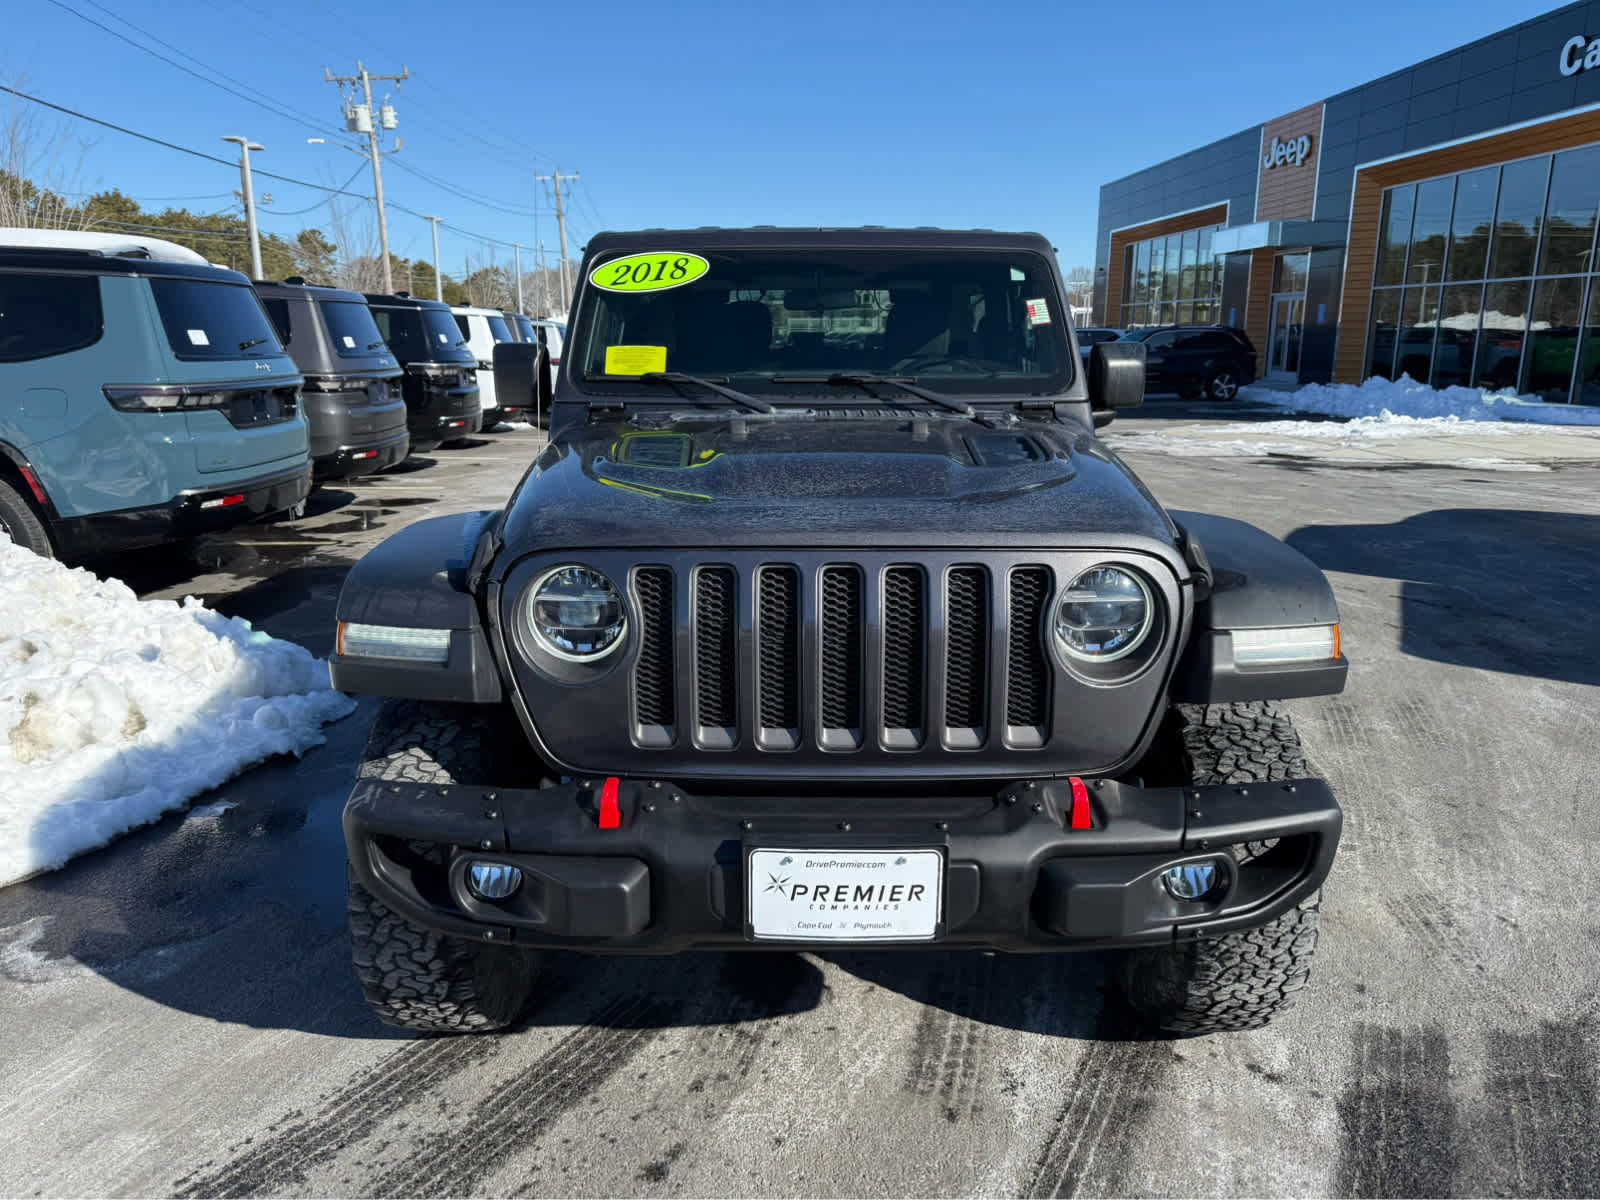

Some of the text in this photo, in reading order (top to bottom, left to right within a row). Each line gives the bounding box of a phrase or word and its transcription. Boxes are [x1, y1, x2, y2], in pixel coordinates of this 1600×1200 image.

[1264, 135, 1311, 169] Jeep
[610, 258, 689, 286] 2018
[790, 884, 925, 902] PREMIER
[809, 903, 899, 911] COMPANIES
[797, 921, 832, 930] Cape Cod
[853, 921, 893, 930] Plymouth
